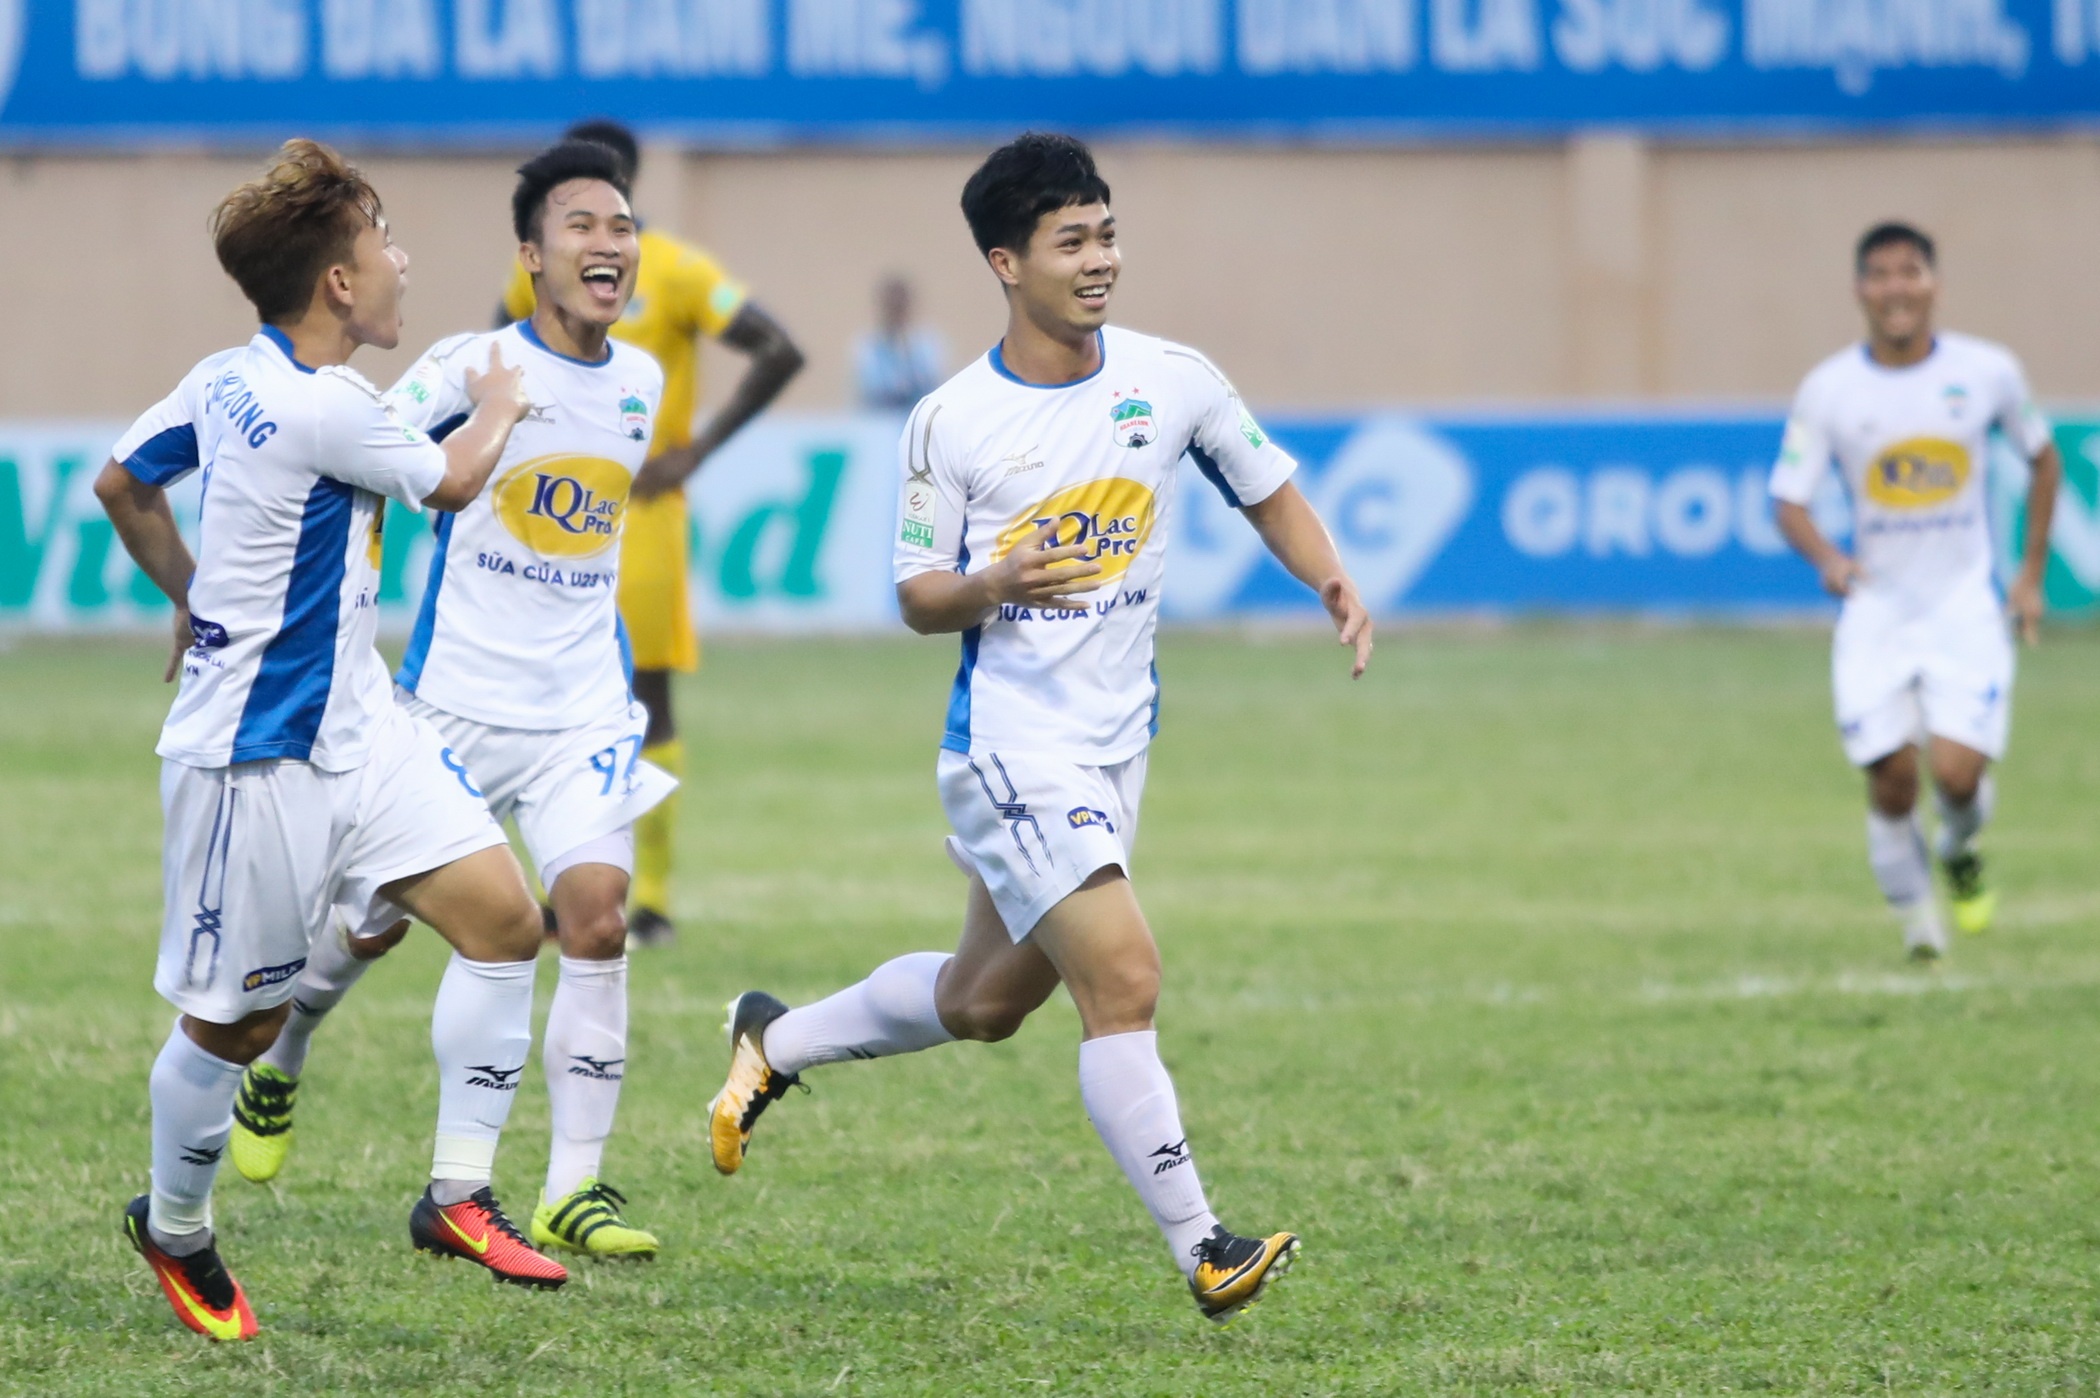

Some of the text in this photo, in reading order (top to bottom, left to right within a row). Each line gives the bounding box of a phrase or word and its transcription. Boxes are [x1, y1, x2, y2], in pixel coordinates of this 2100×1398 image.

[527, 473, 585, 534] IQ
[582, 490, 618, 515] Lac
[583, 515, 613, 535] Pro
[903, 520, 933, 539] NUTI
[1090, 513, 1137, 538] Lac
